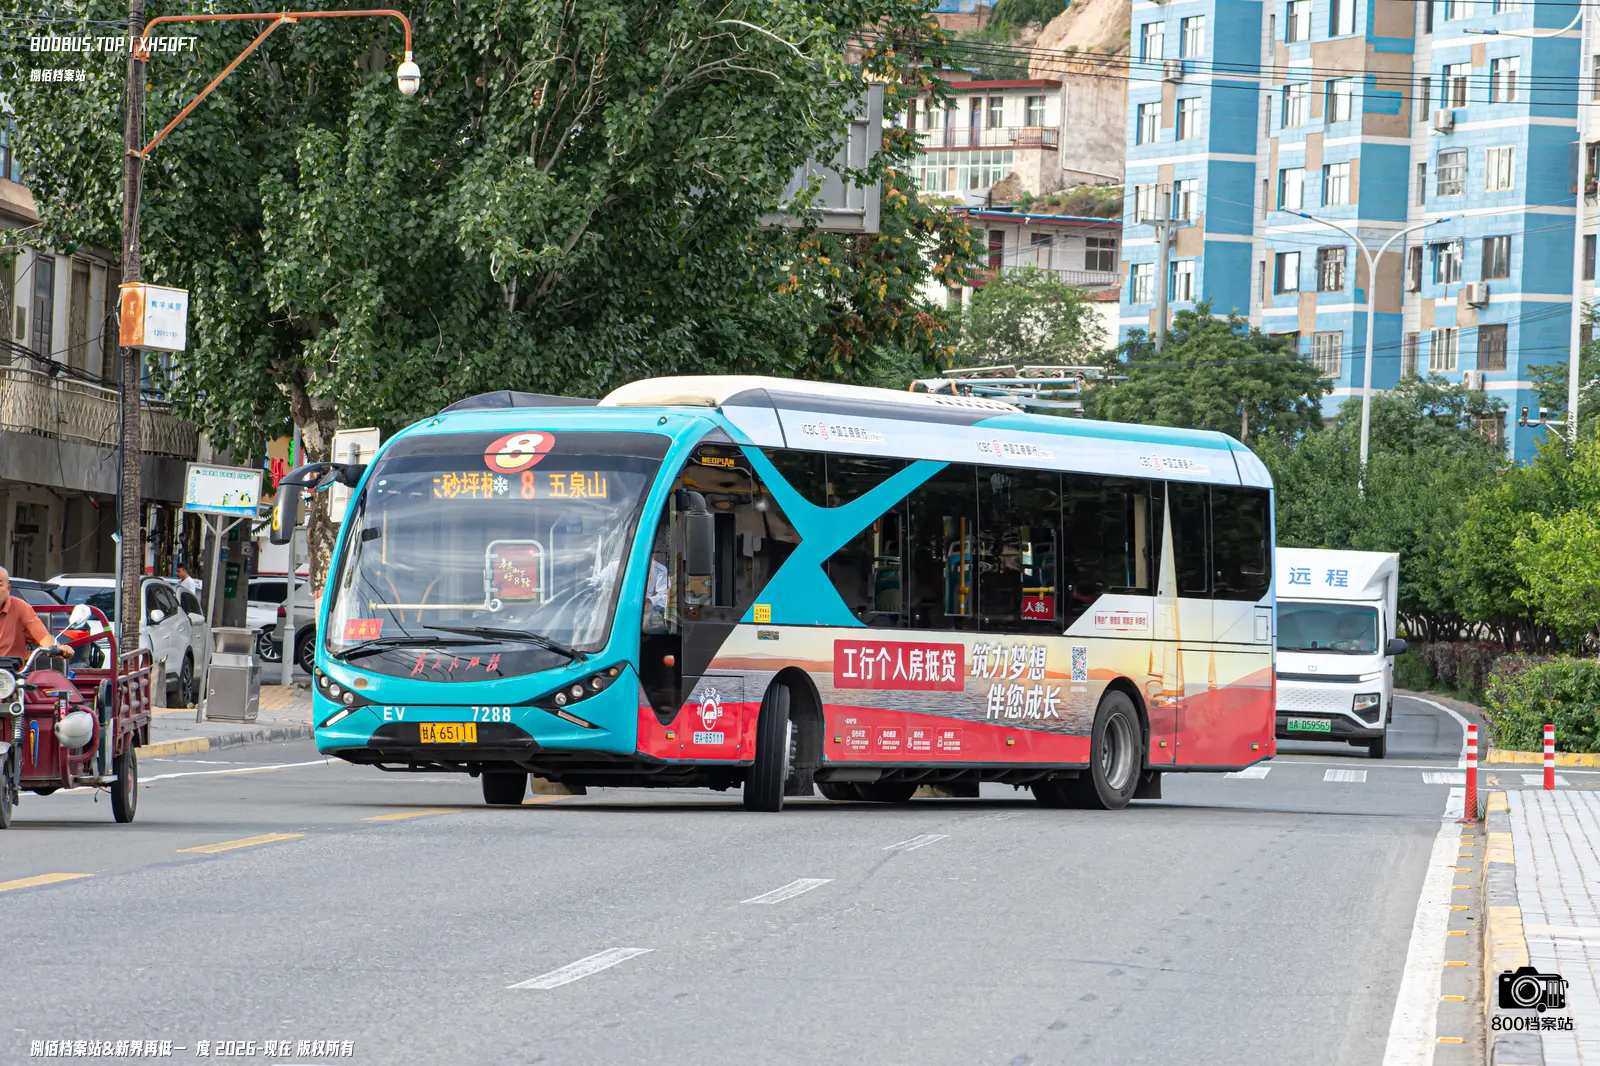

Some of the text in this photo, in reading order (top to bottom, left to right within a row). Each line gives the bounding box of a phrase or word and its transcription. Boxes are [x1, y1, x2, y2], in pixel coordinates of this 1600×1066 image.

[830, 425, 868, 439] 中国工商银行
[495, 433, 544, 468] 8
[701, 456, 735, 468] NEOPLAN
[521, 470, 536, 500] 8
[548, 471, 607, 498] 五泉山
[272, 506, 279, 530] 8
[842, 646, 957, 682] 工行个人房抵贷
[970, 643, 1047, 681] 筑力梦想
[383, 706, 512, 722] EV 7288
[986, 683, 1061, 719] 伴您成长
